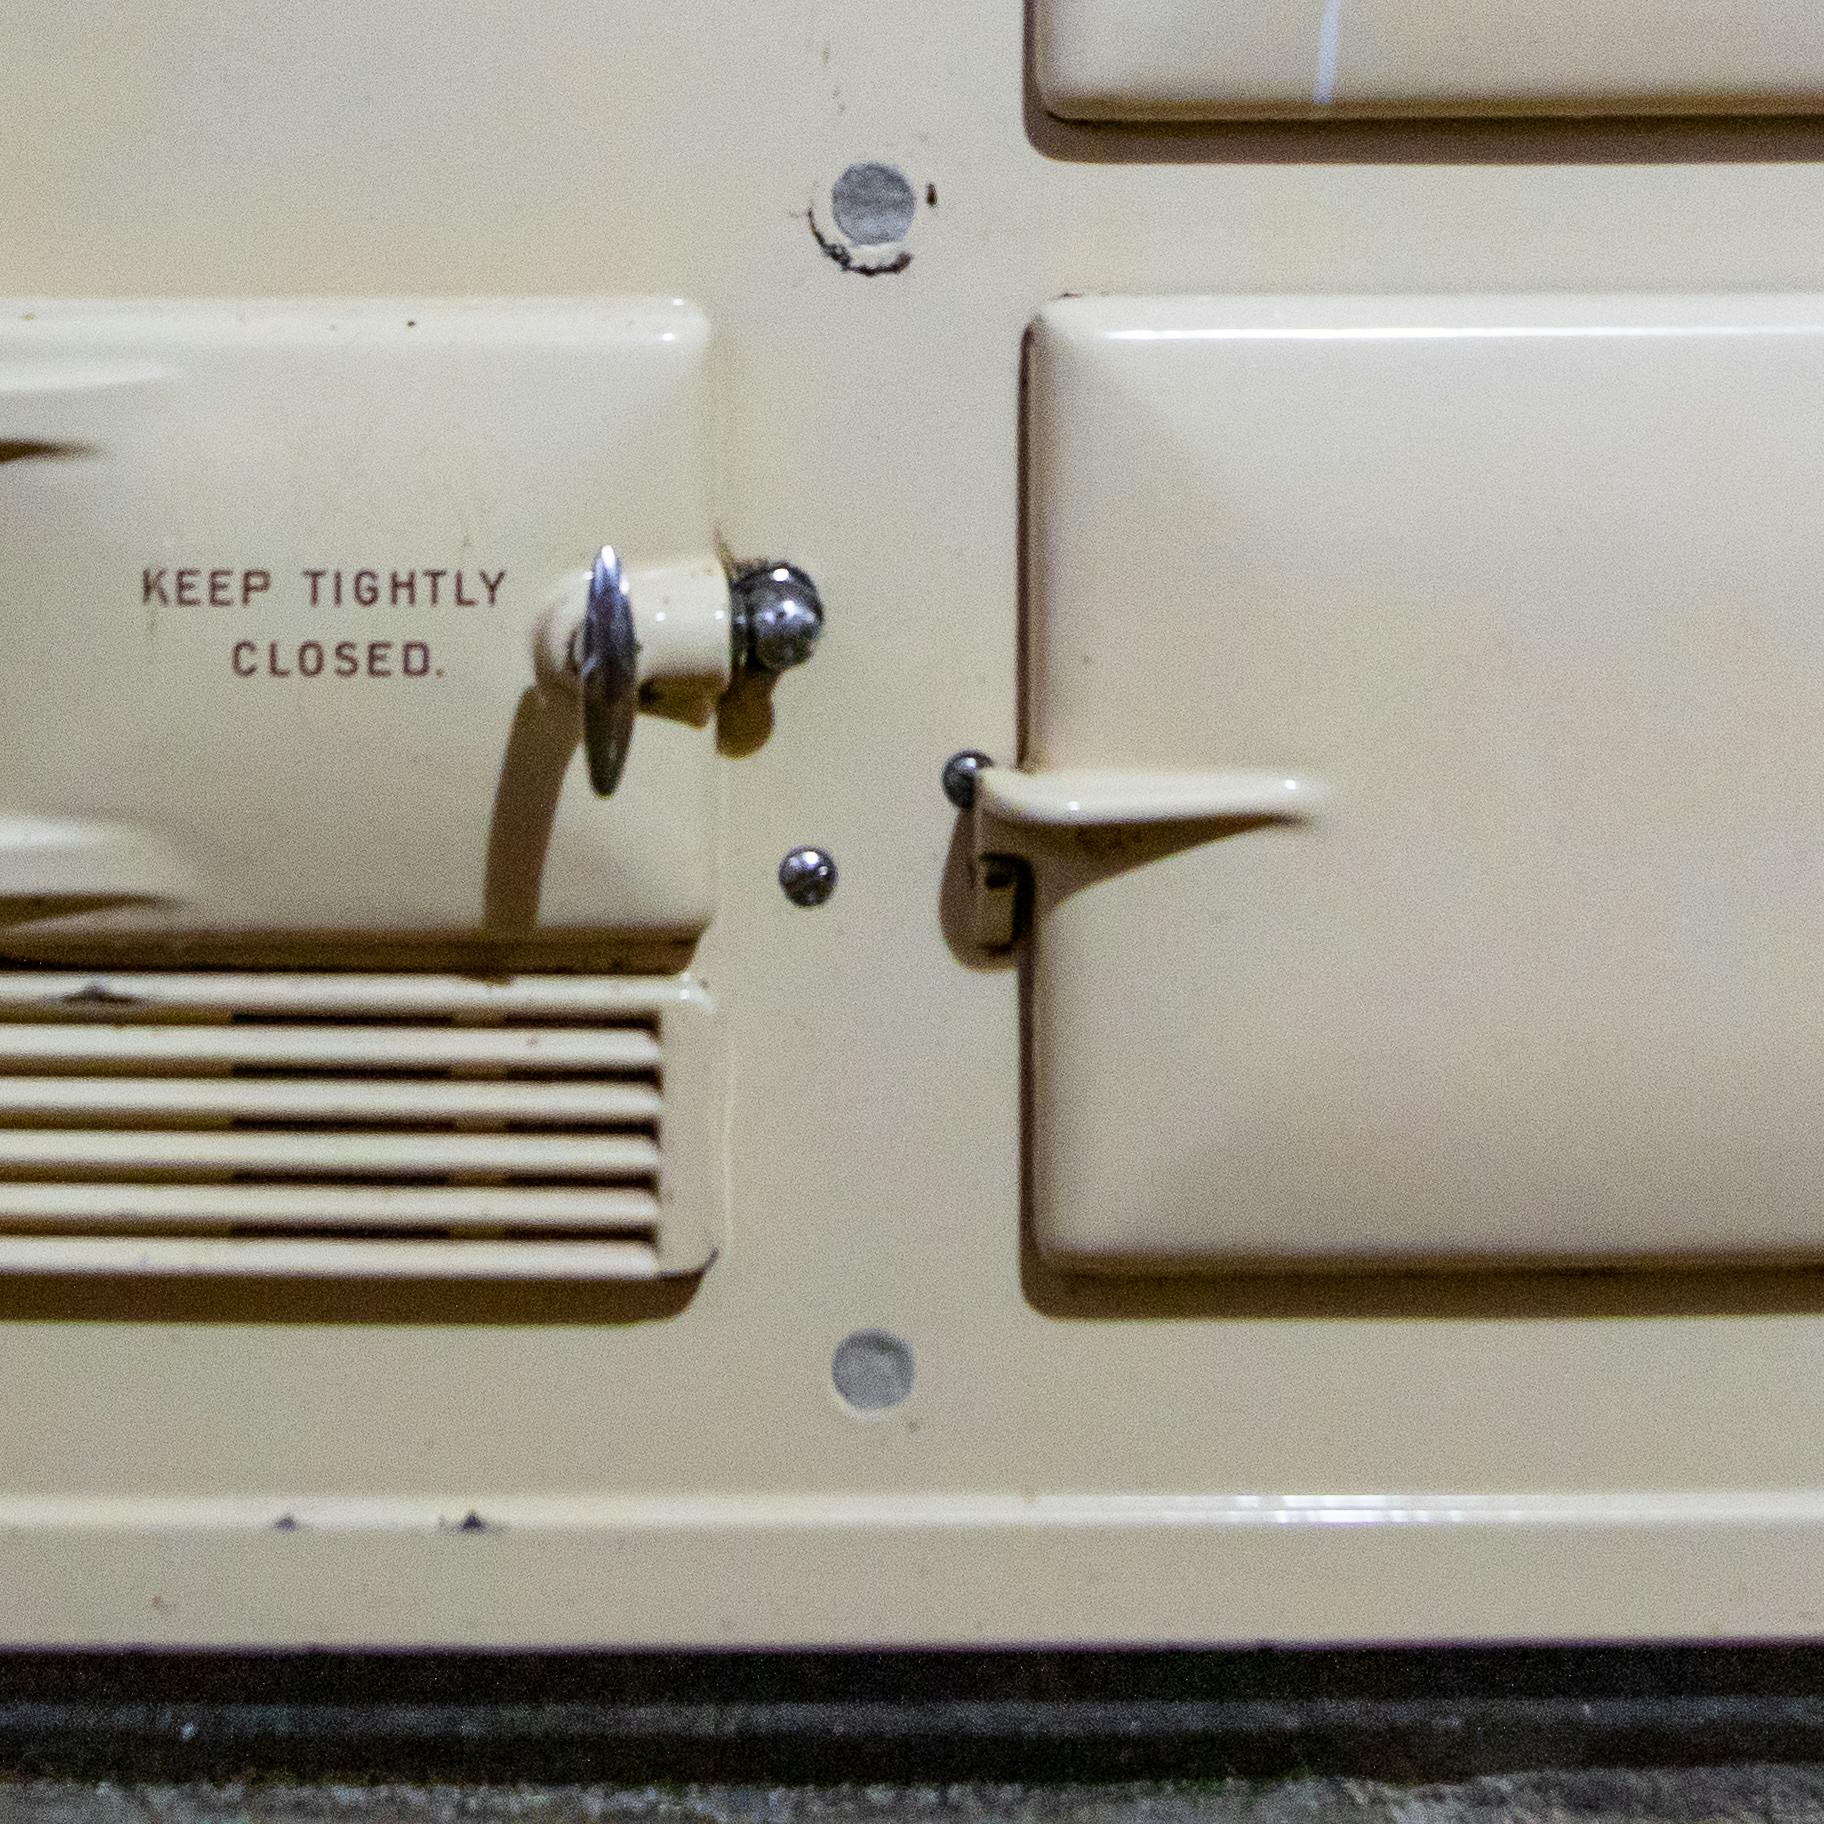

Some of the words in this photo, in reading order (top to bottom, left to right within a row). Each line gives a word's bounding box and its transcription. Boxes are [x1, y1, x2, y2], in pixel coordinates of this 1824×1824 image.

[141, 568, 272, 608] KEEP
[302, 568, 507, 608] TIGHTLY
[230, 639, 446, 678] CLOSED.
